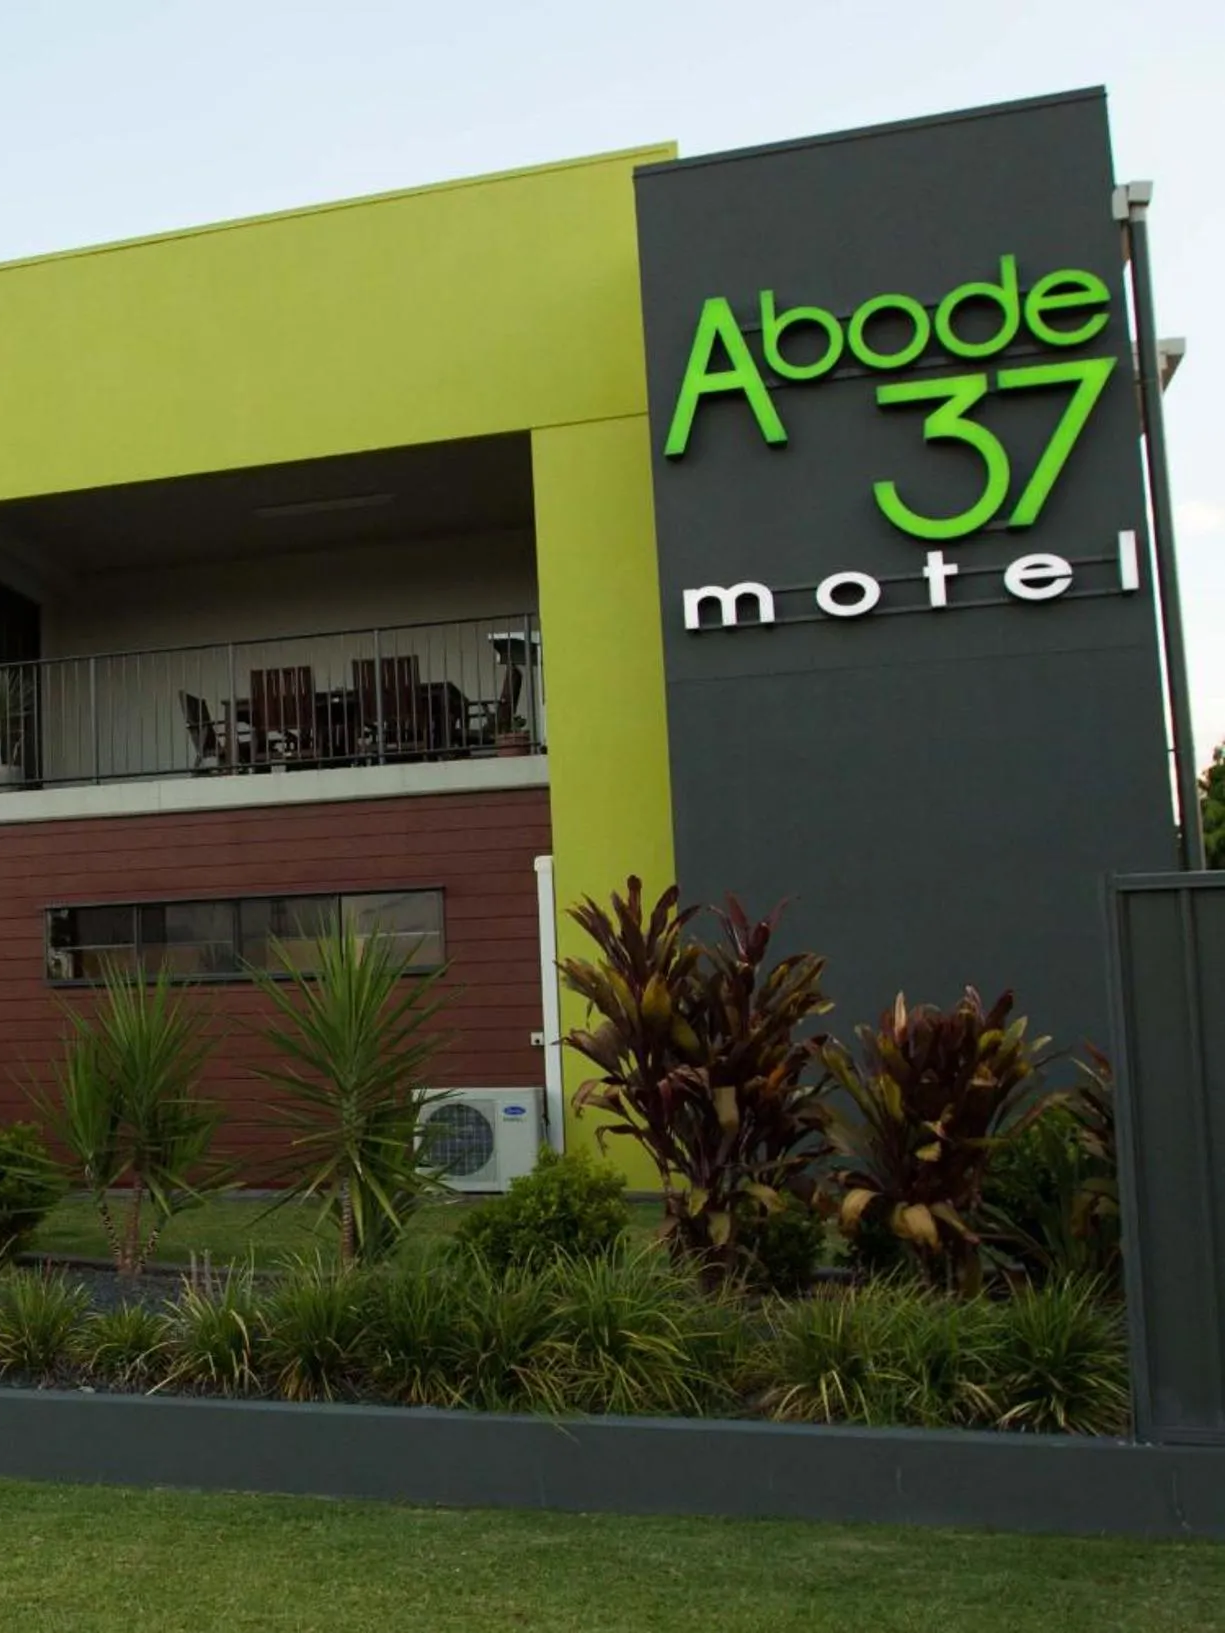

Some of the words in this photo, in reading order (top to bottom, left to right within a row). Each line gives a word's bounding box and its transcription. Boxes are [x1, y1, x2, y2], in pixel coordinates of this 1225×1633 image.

[664, 253, 1111, 460] Abode
[873, 356, 1118, 540] 37
[683, 529, 1139, 630] motel
